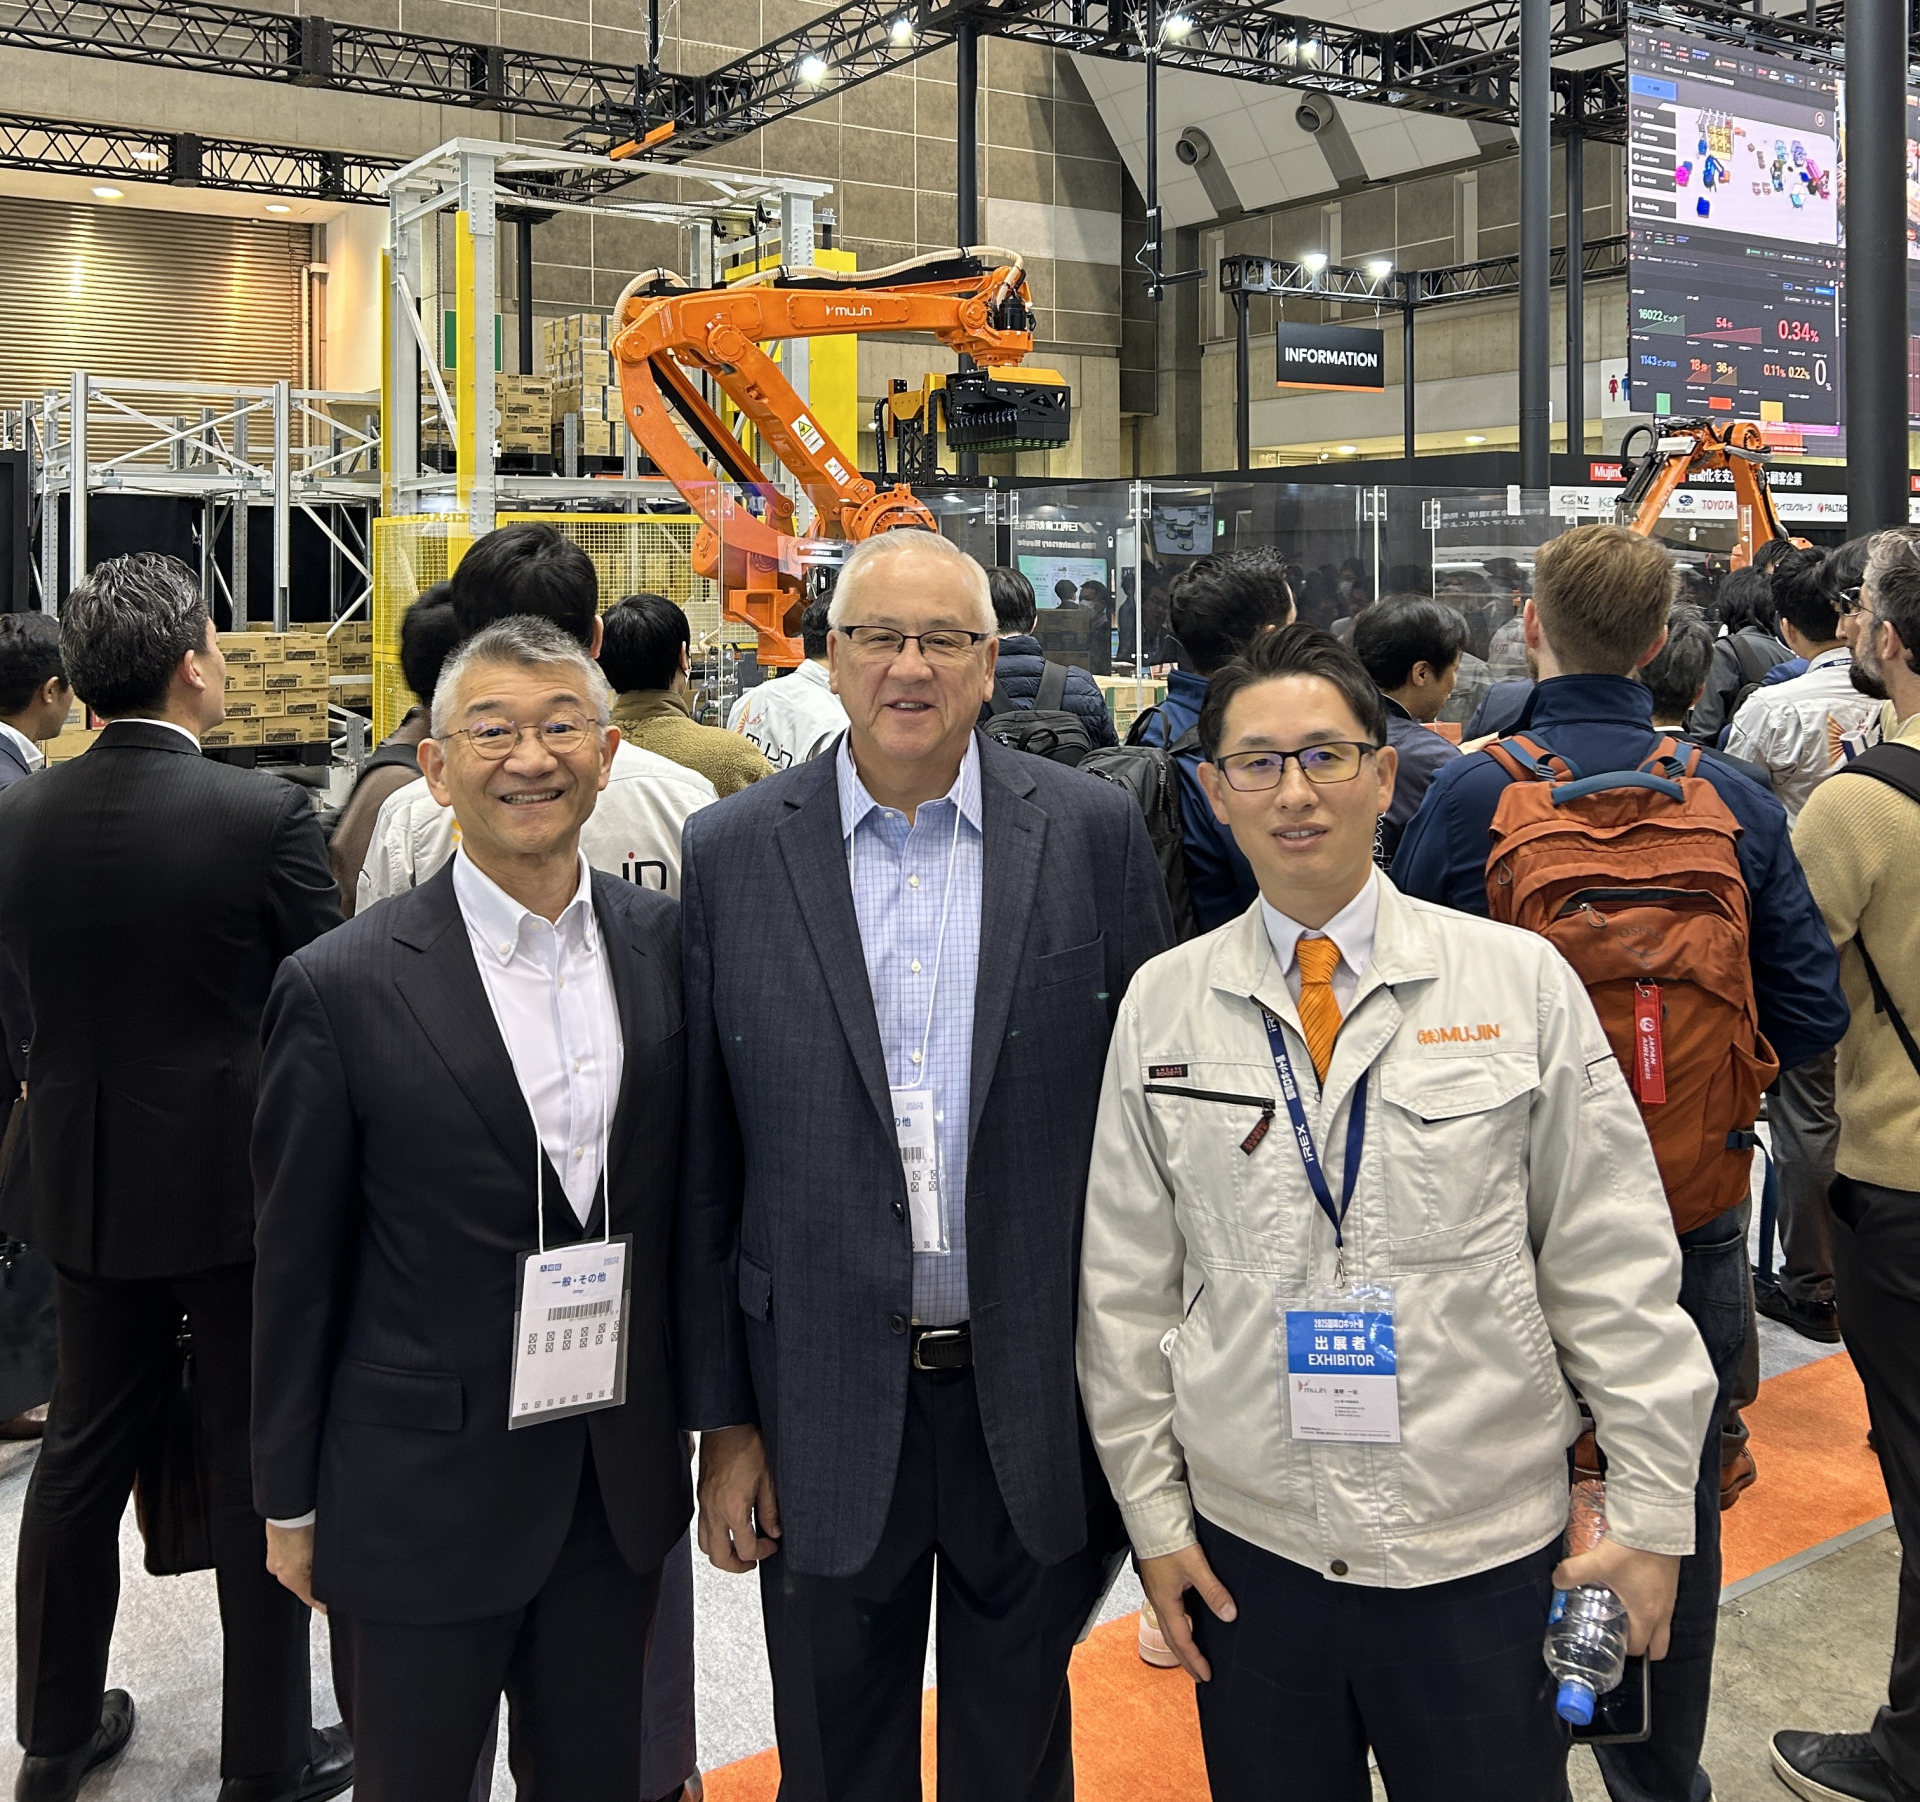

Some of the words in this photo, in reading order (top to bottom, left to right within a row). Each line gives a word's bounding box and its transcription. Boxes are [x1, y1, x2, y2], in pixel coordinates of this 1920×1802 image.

[1778, 319, 1819, 343] 0.34%
[1285, 347, 1378, 368] INFORMATION
[1702, 500, 1734, 511] TOYOTA
[1648, 1034, 1657, 1066] JAPAN
[1295, 1123, 1315, 1163] iREX
[551, 1272, 607, 1287] 一般・その他
[1314, 1336, 1366, 1351] 出展者
[1308, 1353, 1375, 1367] EXHIBITOR
